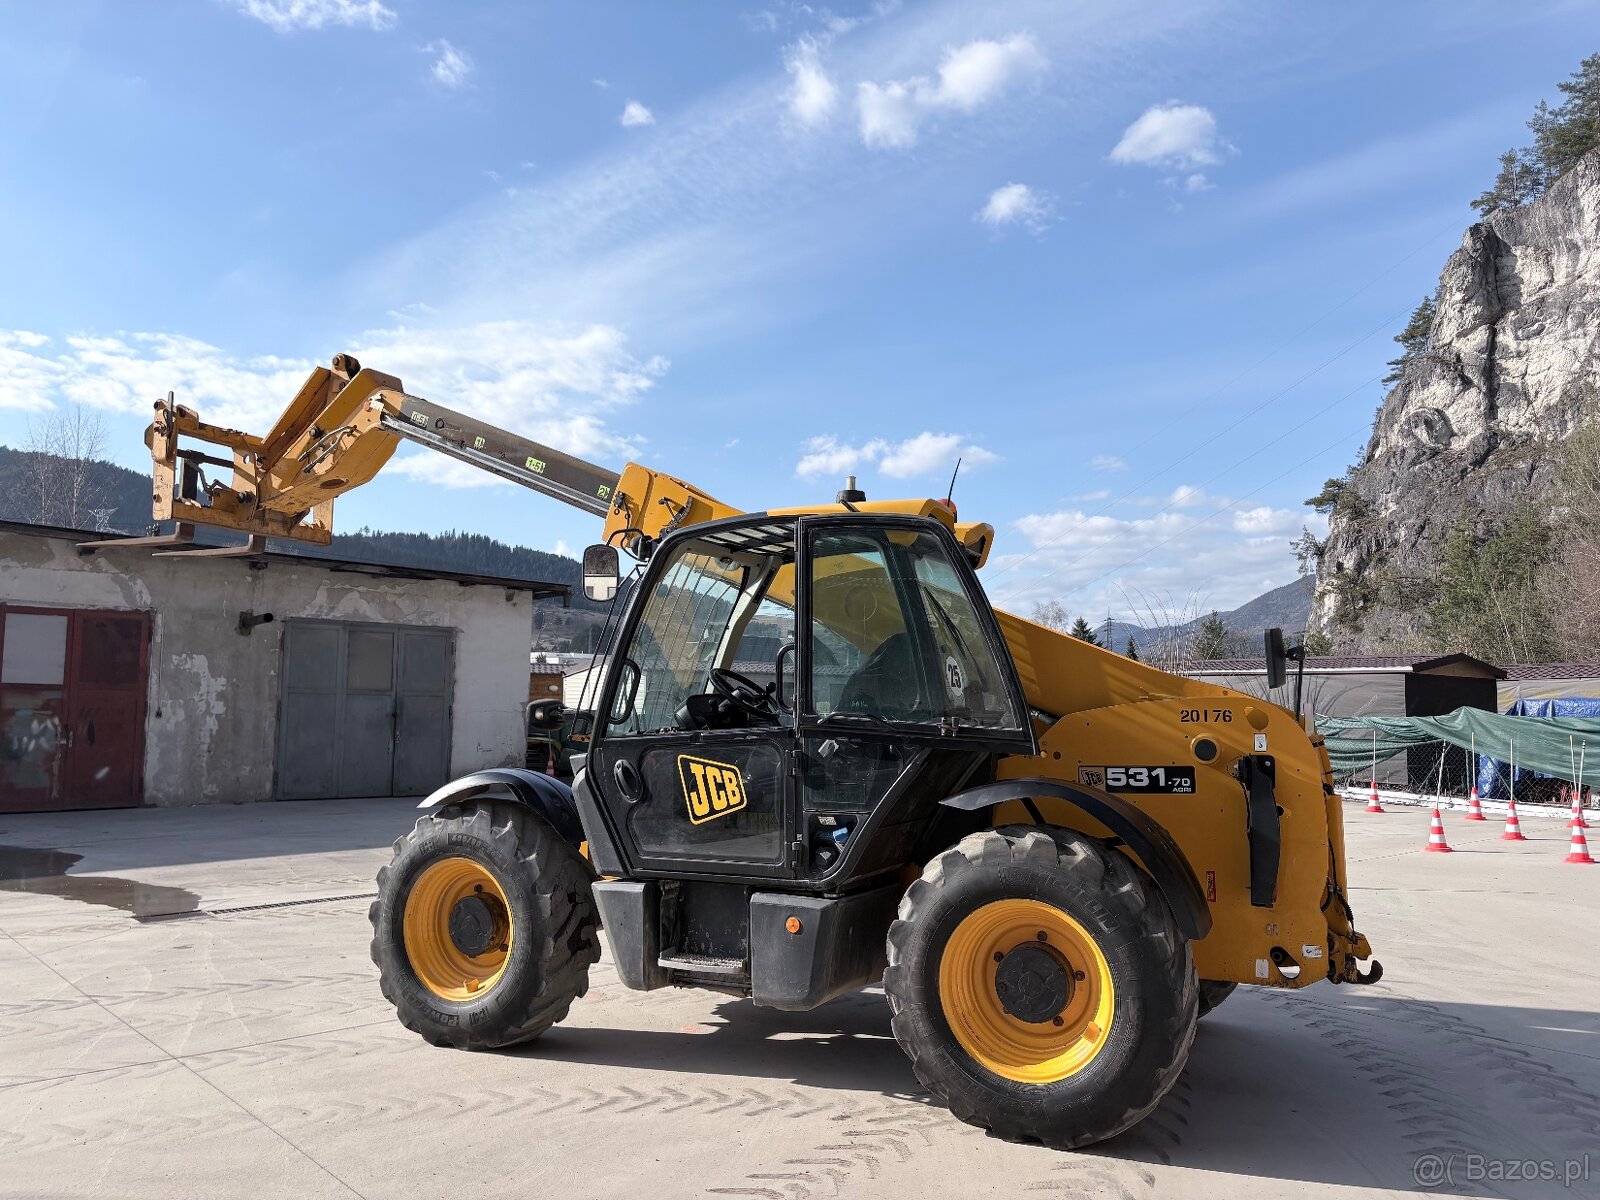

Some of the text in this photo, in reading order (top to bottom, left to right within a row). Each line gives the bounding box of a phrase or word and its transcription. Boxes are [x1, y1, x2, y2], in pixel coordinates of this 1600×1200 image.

[947, 663, 962, 689] 25
[1180, 709, 1233, 723] 20176
[689, 761, 741, 816] JCB
[1085, 770, 1104, 788] JCB
